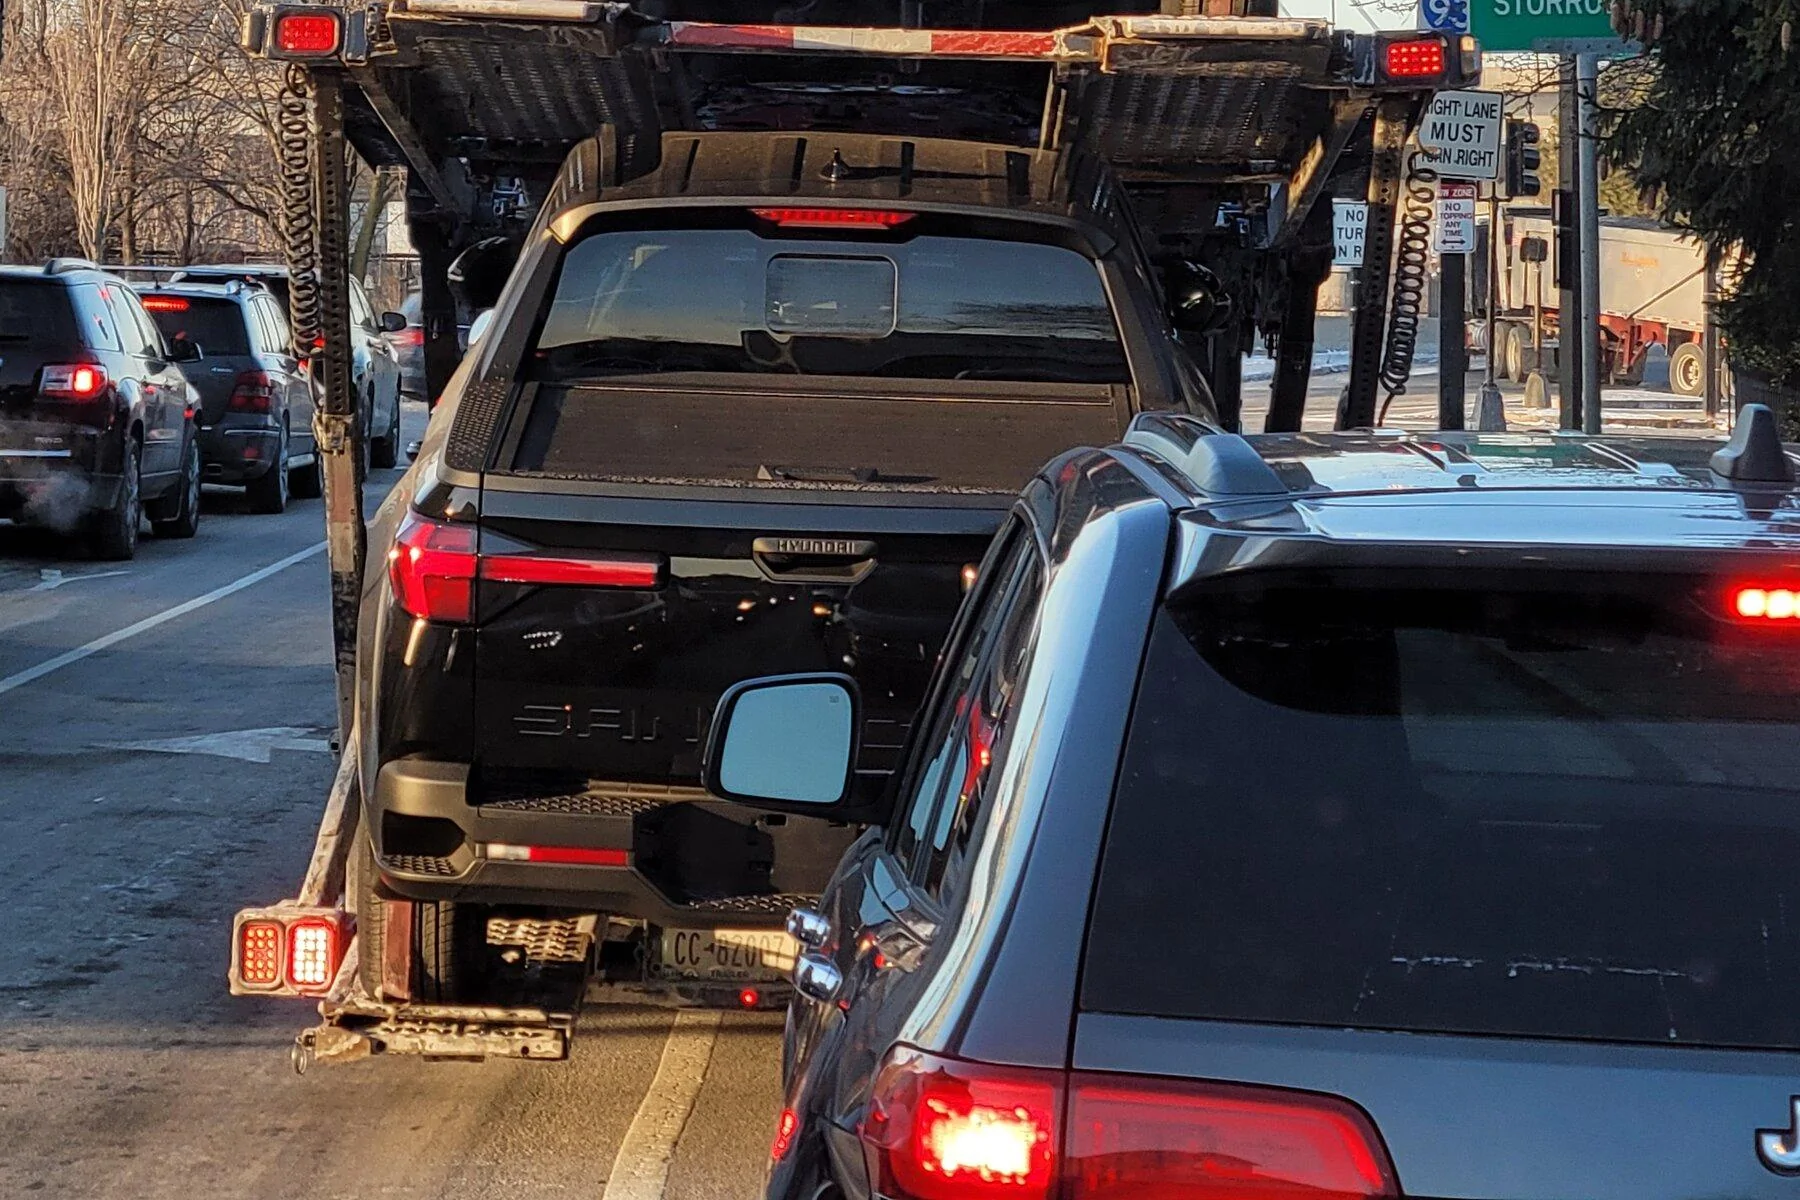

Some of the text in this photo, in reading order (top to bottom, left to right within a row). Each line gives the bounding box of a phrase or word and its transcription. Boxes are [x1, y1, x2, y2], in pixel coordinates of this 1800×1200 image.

[1427, 98, 1498, 119] IGHT LANE
[1430, 121, 1486, 143] MUST
[1456, 148, 1494, 168] RIGHT
[1445, 202, 1461, 211] NO
[1345, 209, 1365, 222] NO
[1337, 227, 1364, 240] TUR
[777, 539, 856, 554] HYUNDAI
